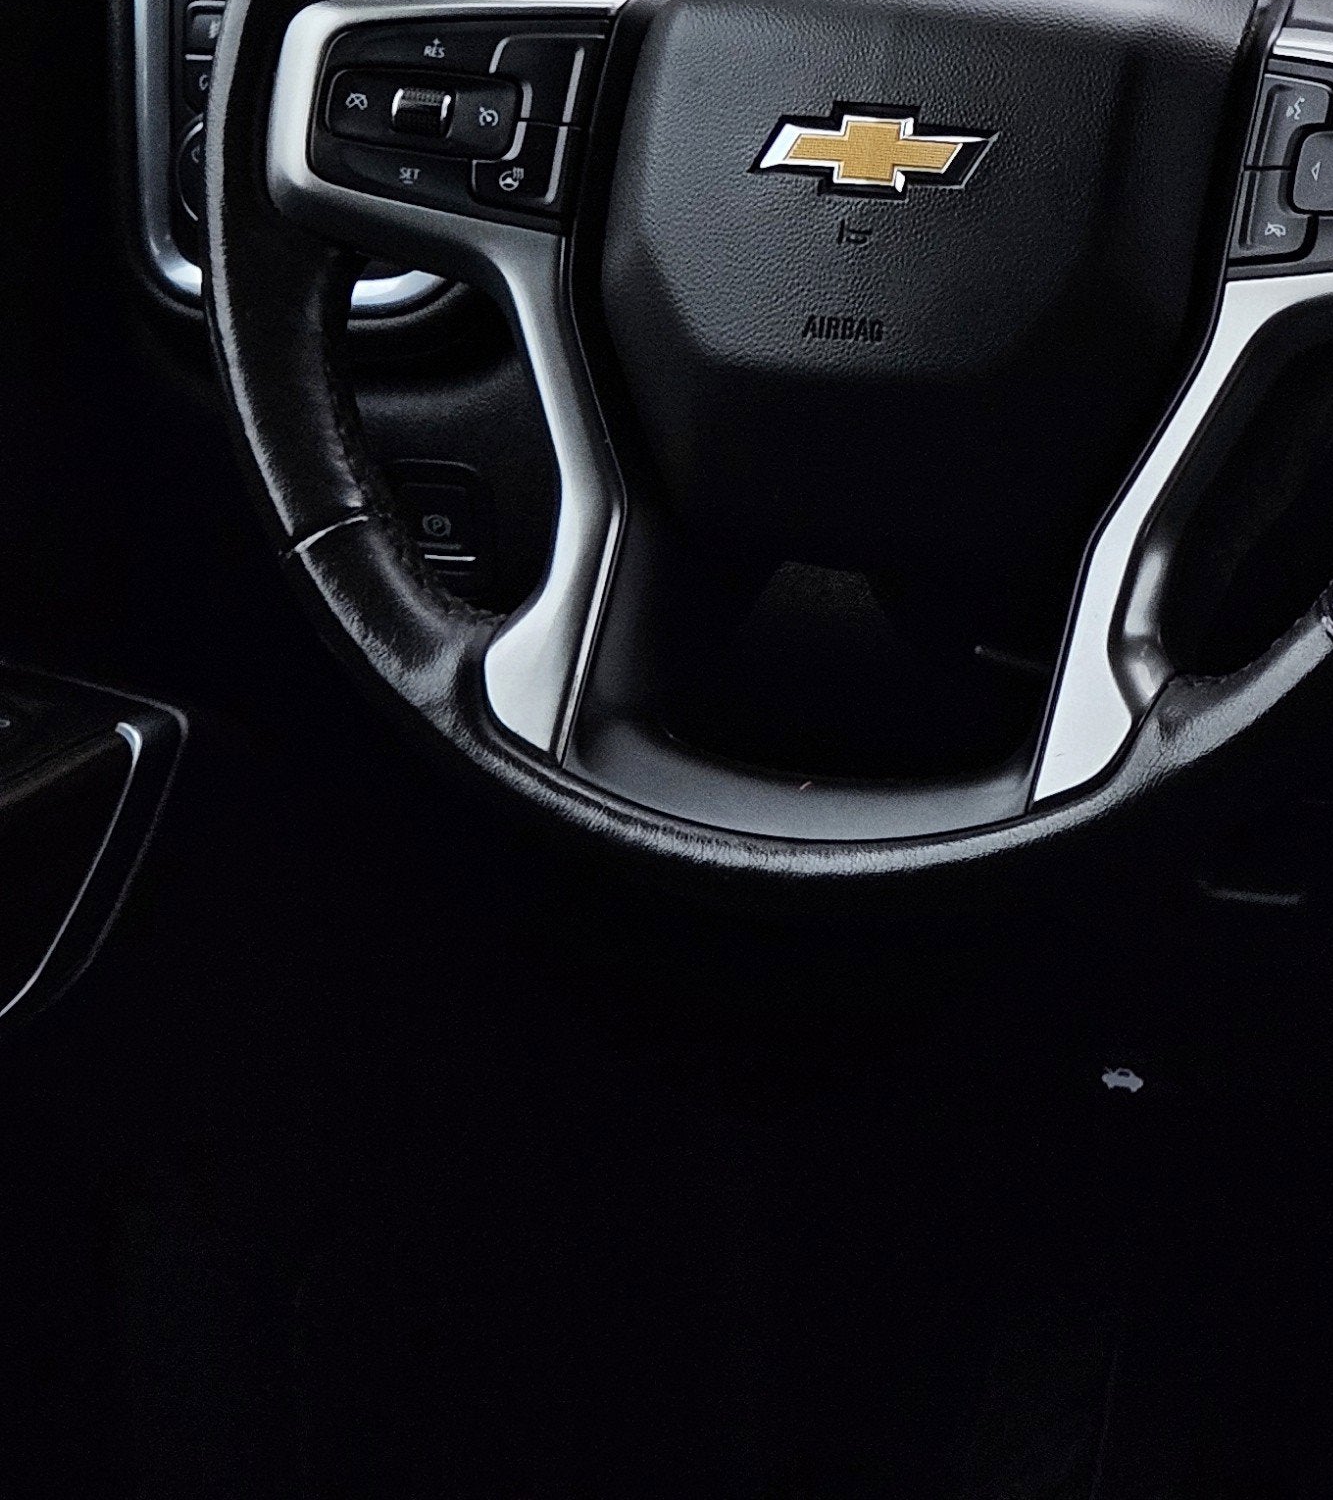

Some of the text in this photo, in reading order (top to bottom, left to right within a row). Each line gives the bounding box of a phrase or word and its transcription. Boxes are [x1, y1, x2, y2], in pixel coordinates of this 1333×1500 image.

[423, 44, 446, 59] RES
[398, 165, 421, 181] SET
[802, 314, 886, 343] AIRBAG
